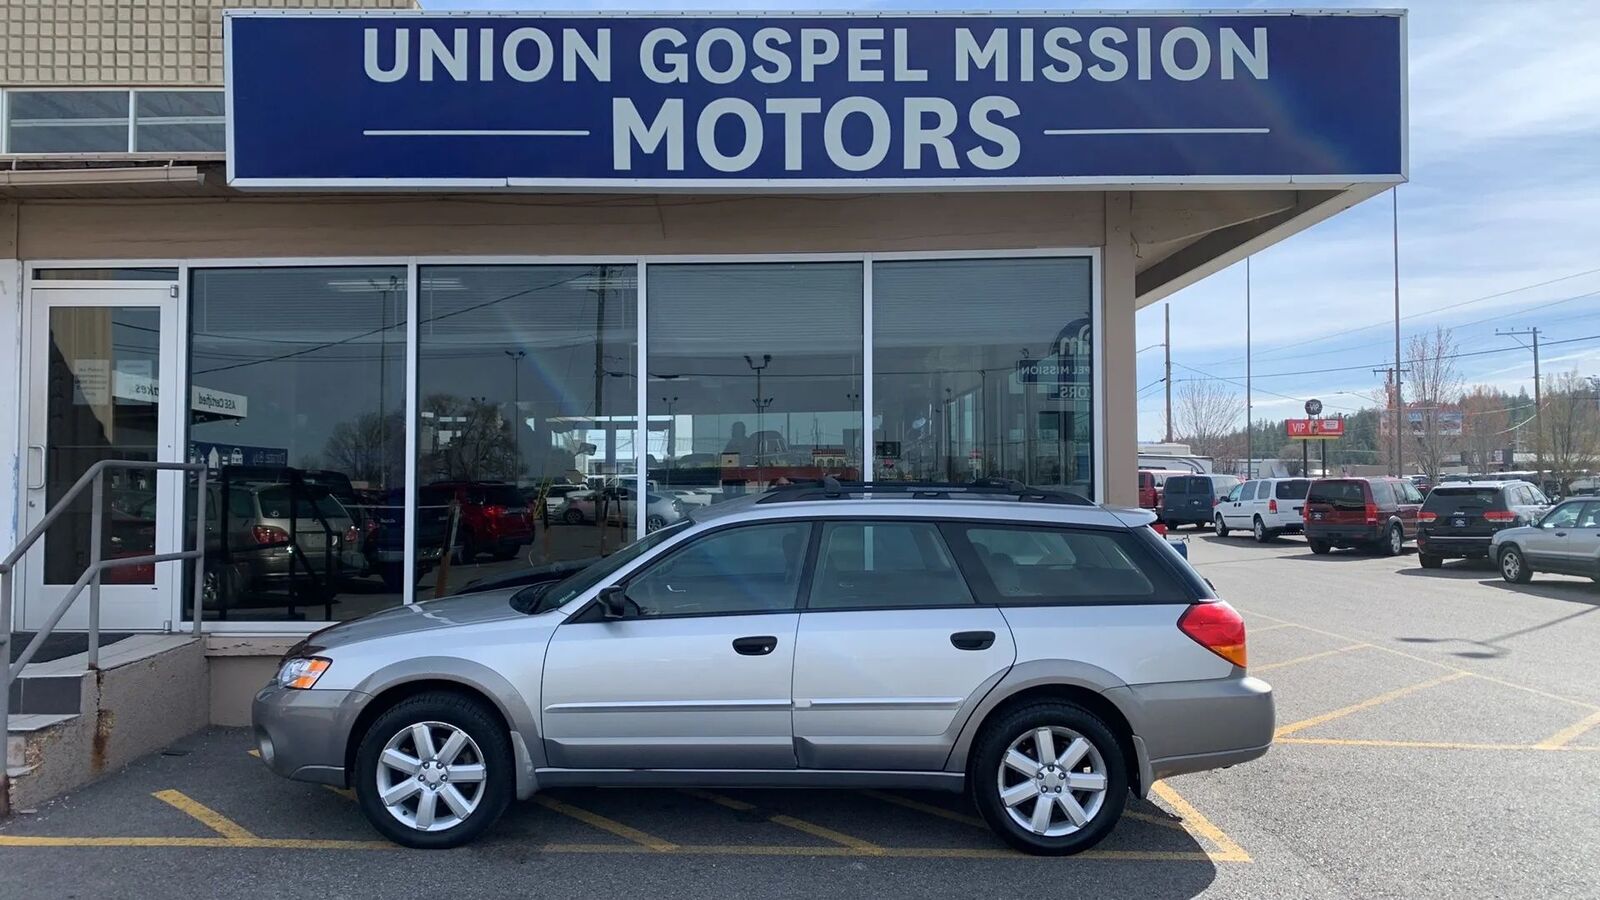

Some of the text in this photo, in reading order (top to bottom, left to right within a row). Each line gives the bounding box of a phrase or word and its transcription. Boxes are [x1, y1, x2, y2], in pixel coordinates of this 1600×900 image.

[363, 26, 1269, 85] UNION GOSPEL MISSION
[612, 96, 1022, 172] MOTORS
[1292, 423, 1306, 433] VIP
